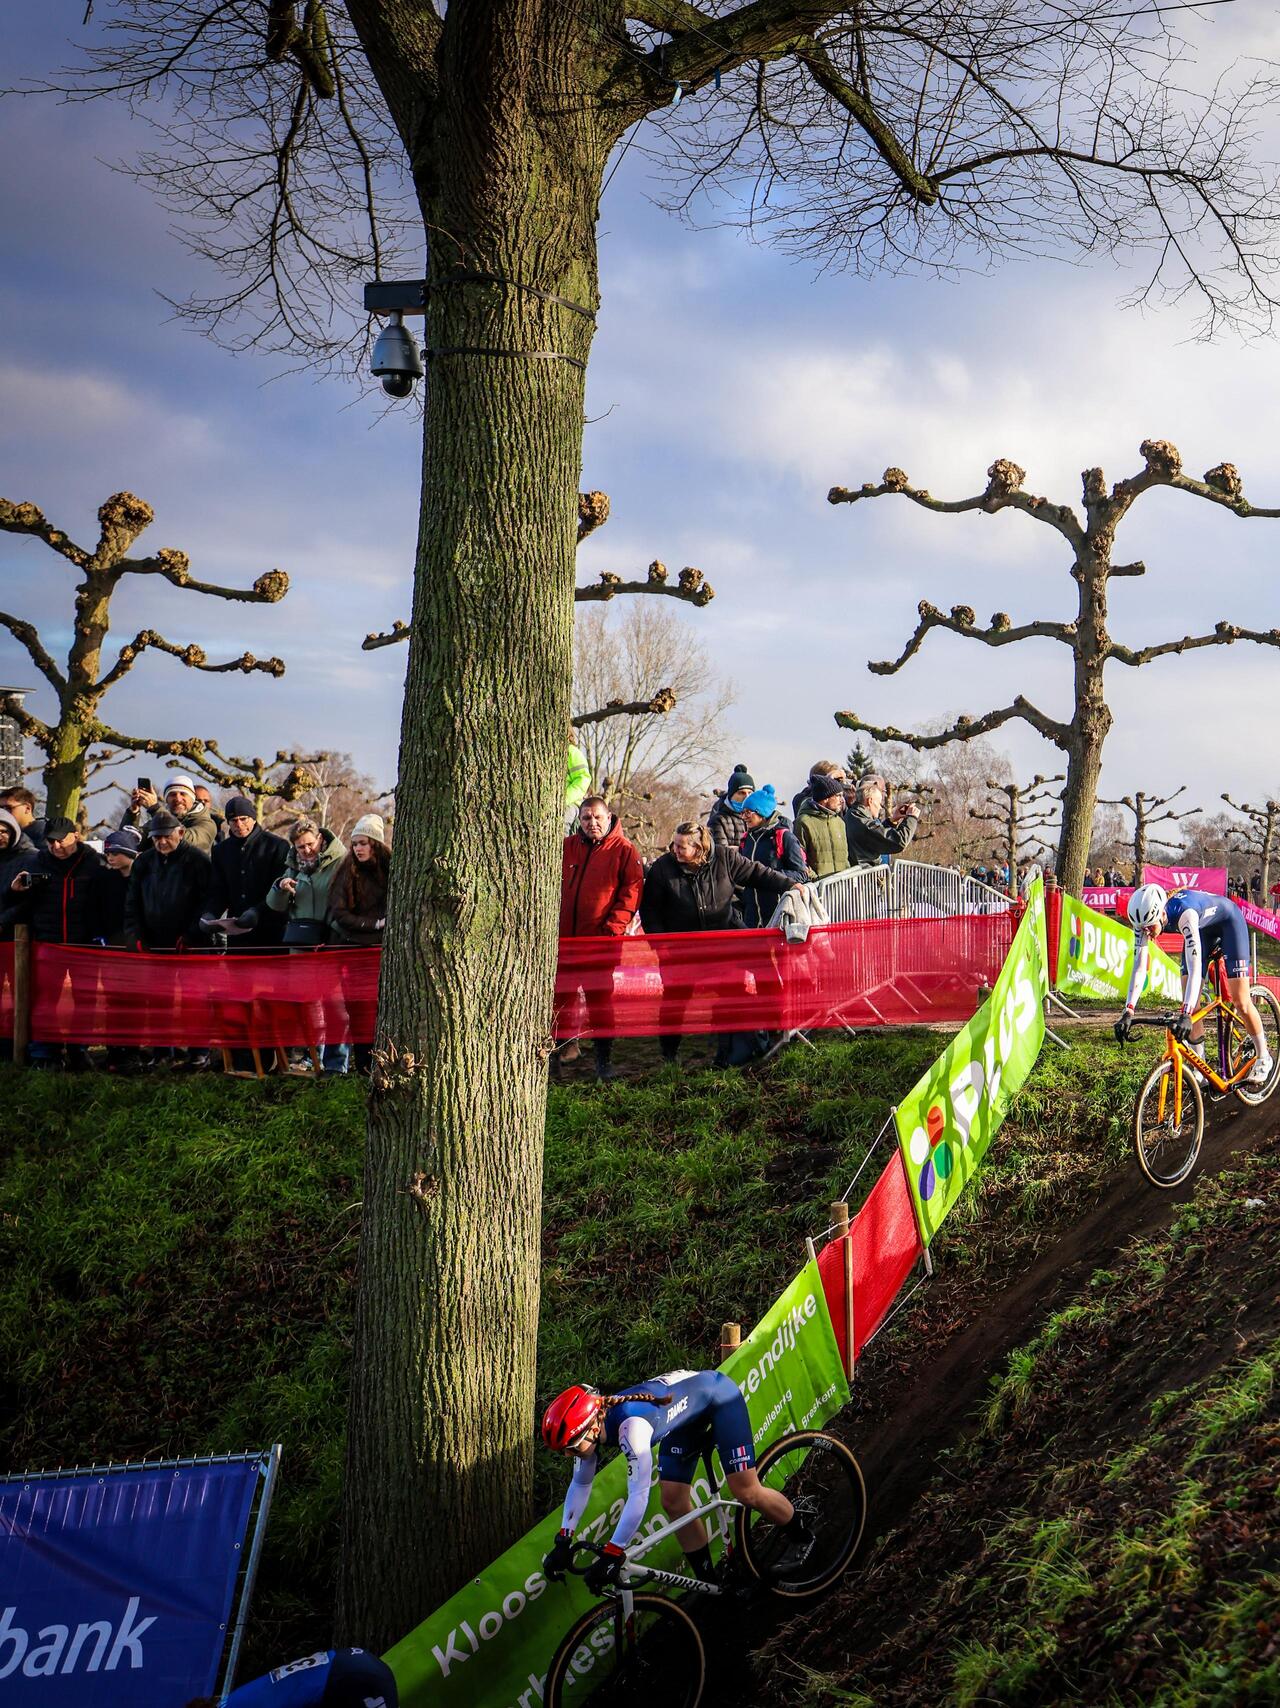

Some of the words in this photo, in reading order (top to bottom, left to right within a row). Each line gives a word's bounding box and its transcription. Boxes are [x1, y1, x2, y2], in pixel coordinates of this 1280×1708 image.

[1172, 873, 1199, 887] WZ
[1081, 921, 1129, 979] PLUS
[666, 1395, 689, 1425] FRANCE
[801, 1383, 838, 1429] Breskens
